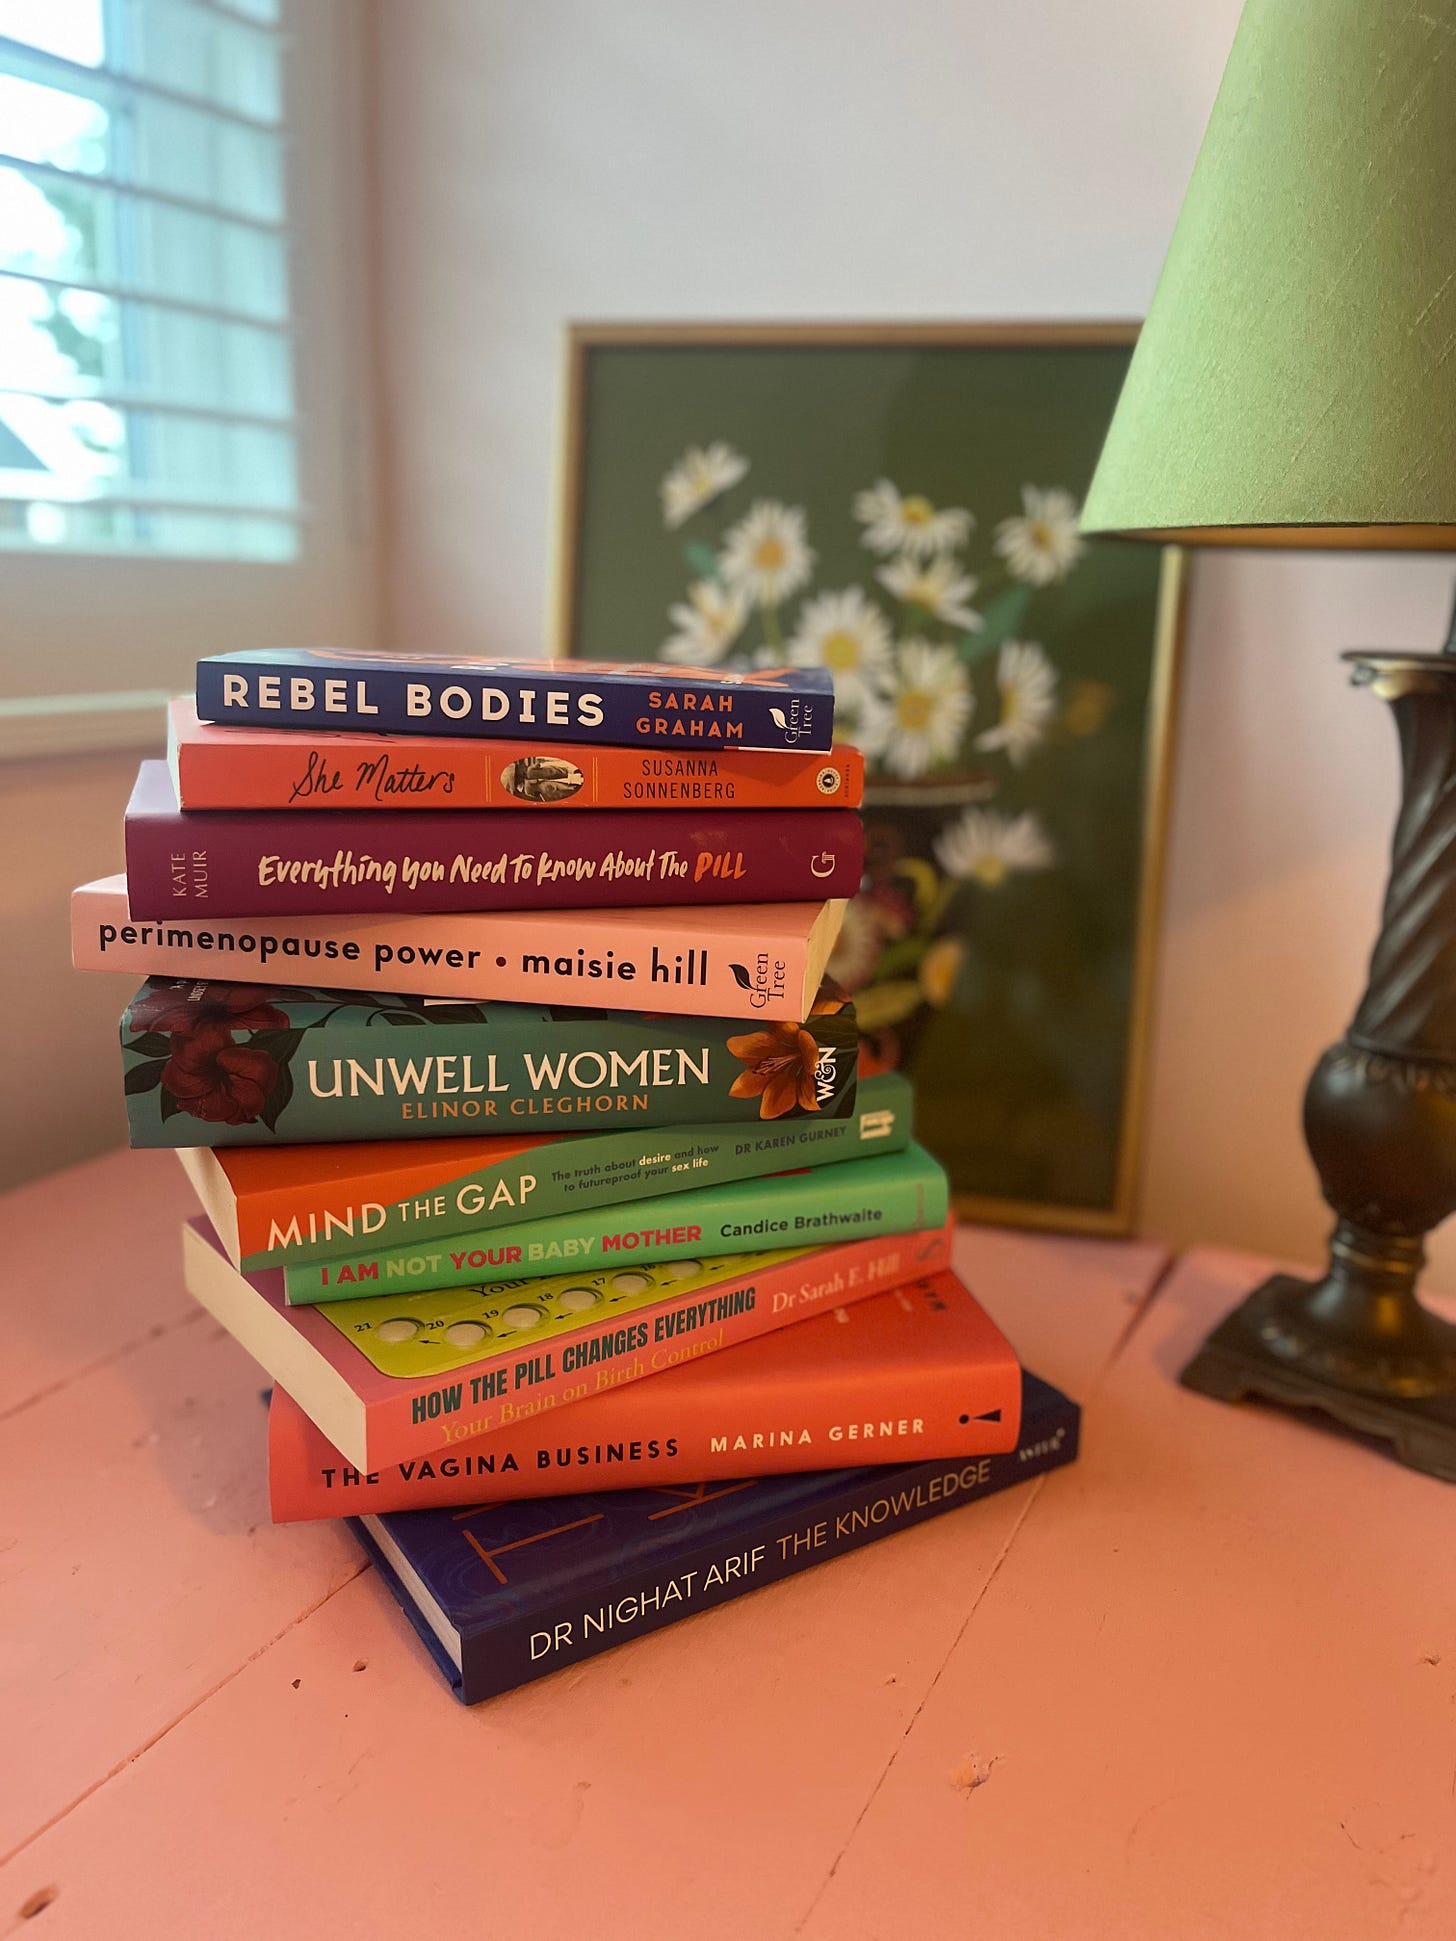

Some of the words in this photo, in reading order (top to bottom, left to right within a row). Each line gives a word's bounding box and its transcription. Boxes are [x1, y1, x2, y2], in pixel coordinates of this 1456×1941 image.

[223, 674, 379, 714] REBEL
[407, 684, 604, 727] BODIES
[649, 692, 733, 713] SARAH
[785, 699, 800, 743] Green
[798, 705, 813, 738] Tree
[636, 717, 743, 739] GRAHAM
[289, 751, 343, 803] She
[356, 754, 455, 801] Matters
[642, 759, 718, 777] SUSANNA
[623, 782, 735, 799] SONNENBERG
[171, 853, 187, 897] KATE
[192, 850, 209, 899] MUIR
[258, 850, 397, 894] Everything
[450, 853, 508, 884] Need
[509, 853, 536, 884] To
[599, 849, 656, 881] About
[659, 850, 689, 880] The
[694, 852, 748, 883] PILL
[99, 920, 361, 964] perimenopause
[375, 944, 481, 972] power
[522, 949, 637, 981] maisie
[651, 947, 708, 986] hill
[750, 952, 769, 1008] Green
[767, 960, 786, 1001] Tree
[308, 1055, 511, 1098] UNWELL
[522, 1048, 710, 1091] WOMEN
[402, 1100, 498, 1120] ELINOR
[510, 1094, 648, 1116] CLEGHORN
[735, 1142, 751, 1155] DR
[755, 1135, 796, 1151] KAREN
[800, 1126, 848, 1143] GURNEY
[552, 1171, 571, 1182] The
[574, 1166, 601, 1177] truth
[604, 1159, 636, 1172] about
[639, 1153, 671, 1166] desire
[674, 1147, 694, 1159] and
[697, 1144, 719, 1155] how
[564, 1183, 575, 1192] to
[578, 1168, 642, 1189] futureproof
[644, 1167, 669, 1180] your
[671, 1163, 690, 1173] sex
[692, 1157, 709, 1169] life
[267, 1203, 387, 1251] MIND
[398, 1196, 446, 1222] THE
[456, 1175, 537, 1215] GAP
[720, 1218, 788, 1237] Candice
[794, 1208, 883, 1229] Brathwaite
[321, 1267, 329, 1285] I
[337, 1262, 379, 1284] AM
[386, 1255, 442, 1279] NOT
[450, 1246, 522, 1270] YOUR
[528, 1237, 595, 1261] BABY
[602, 1225, 702, 1253] MOTHER
[537, 1292, 554, 1302] 18
[591, 1277, 606, 1286] 17
[771, 1292, 796, 1313] Dr
[799, 1272, 845, 1303] Sarah
[868, 1252, 900, 1281] Hill
[354, 1322, 372, 1333] 21
[426, 1320, 444, 1331] 20
[481, 1309, 499, 1320] 19
[412, 1383, 463, 1425] HOW
[470, 1369, 508, 1404] THE
[514, 1355, 555, 1390] PILL
[562, 1322, 648, 1373] CHANGES
[654, 1286, 756, 1342] EVERYTHING
[440, 1414, 493, 1444] Your
[499, 1388, 556, 1425] Brain
[562, 1382, 588, 1400] on
[594, 1357, 645, 1390] Birth
[651, 1328, 724, 1370] Control
[711, 1428, 812, 1453] MARINA
[828, 1419, 925, 1441] GERNER
[399, 1453, 519, 1481] VAGINA
[536, 1438, 679, 1469] BUSINESS
[776, 1522, 828, 1560] THE
[835, 1459, 992, 1540] KNOWLEDGE
[530, 1622, 573, 1661] DR
[584, 1571, 699, 1639] NIGHAT
[703, 1545, 766, 1592] ARIF
